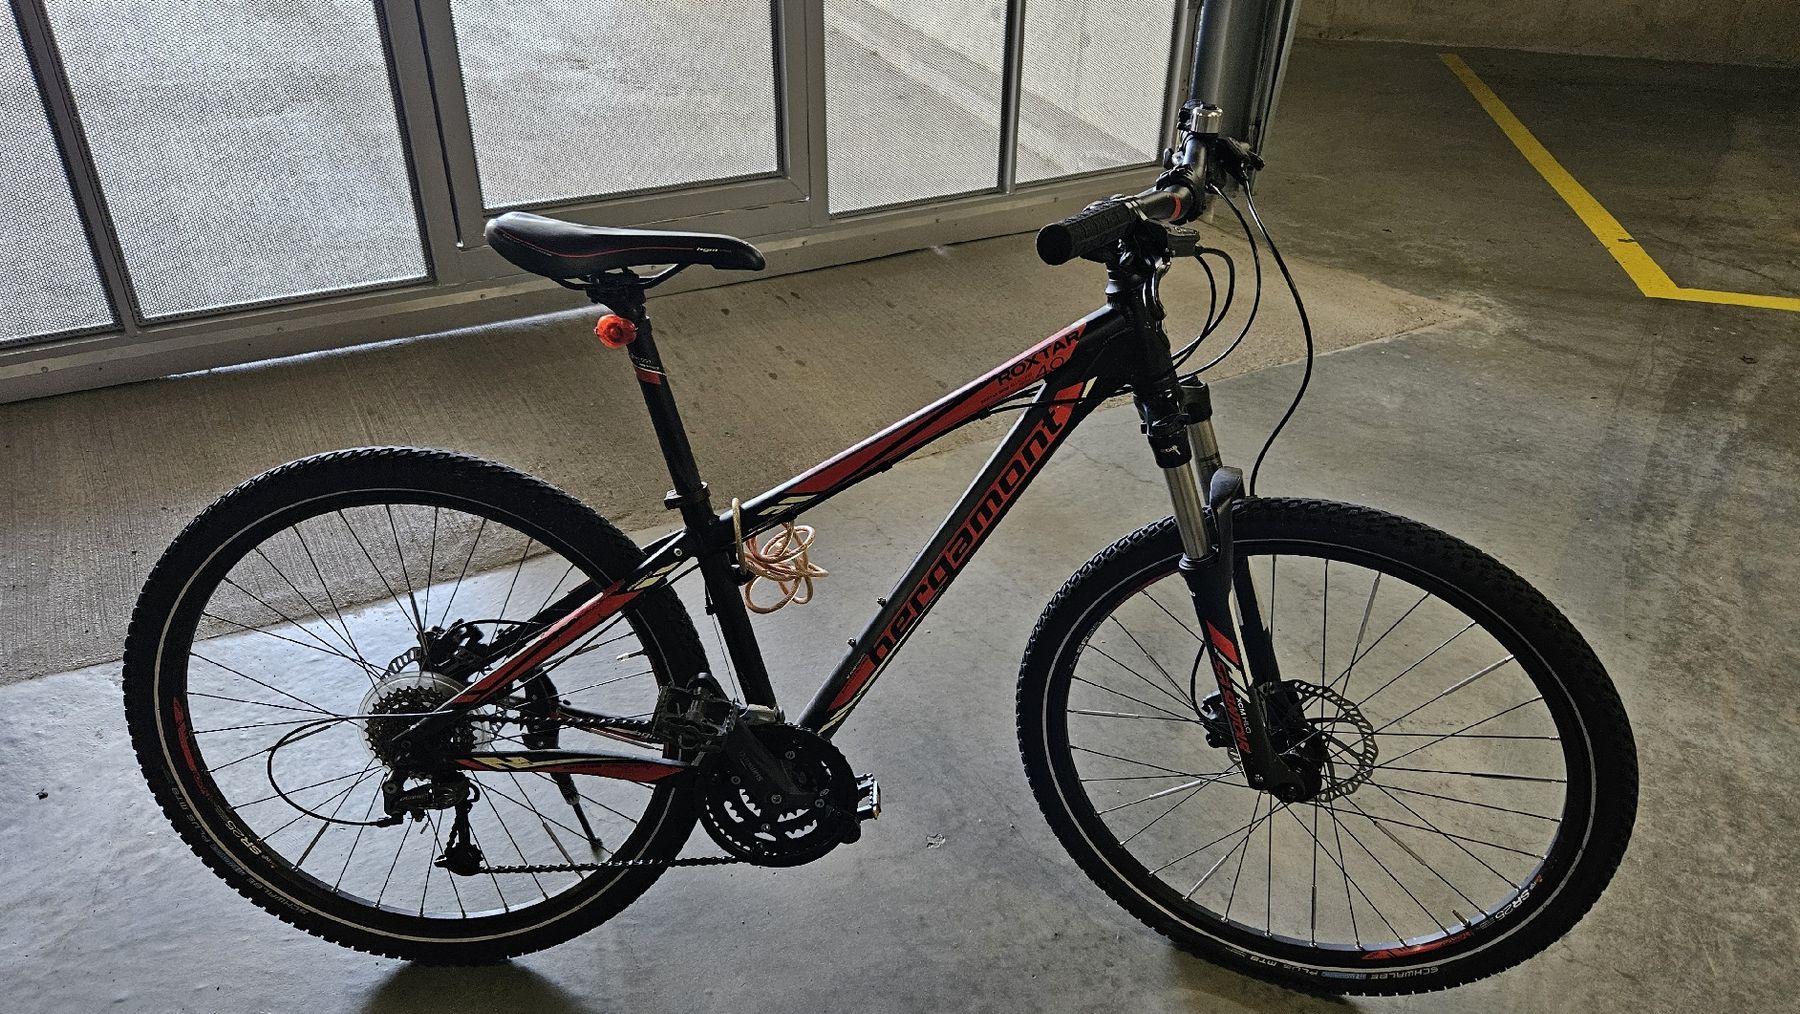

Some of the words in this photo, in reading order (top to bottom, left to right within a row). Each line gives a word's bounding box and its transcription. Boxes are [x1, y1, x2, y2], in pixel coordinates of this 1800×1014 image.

[997, 329, 1080, 386] ROXTAR
[865, 408, 1063, 667] bergamont
[225, 819, 262, 855] SR25
[1494, 891, 1530, 922] SR25
[1371, 966, 1440, 981] SCHWALBE
